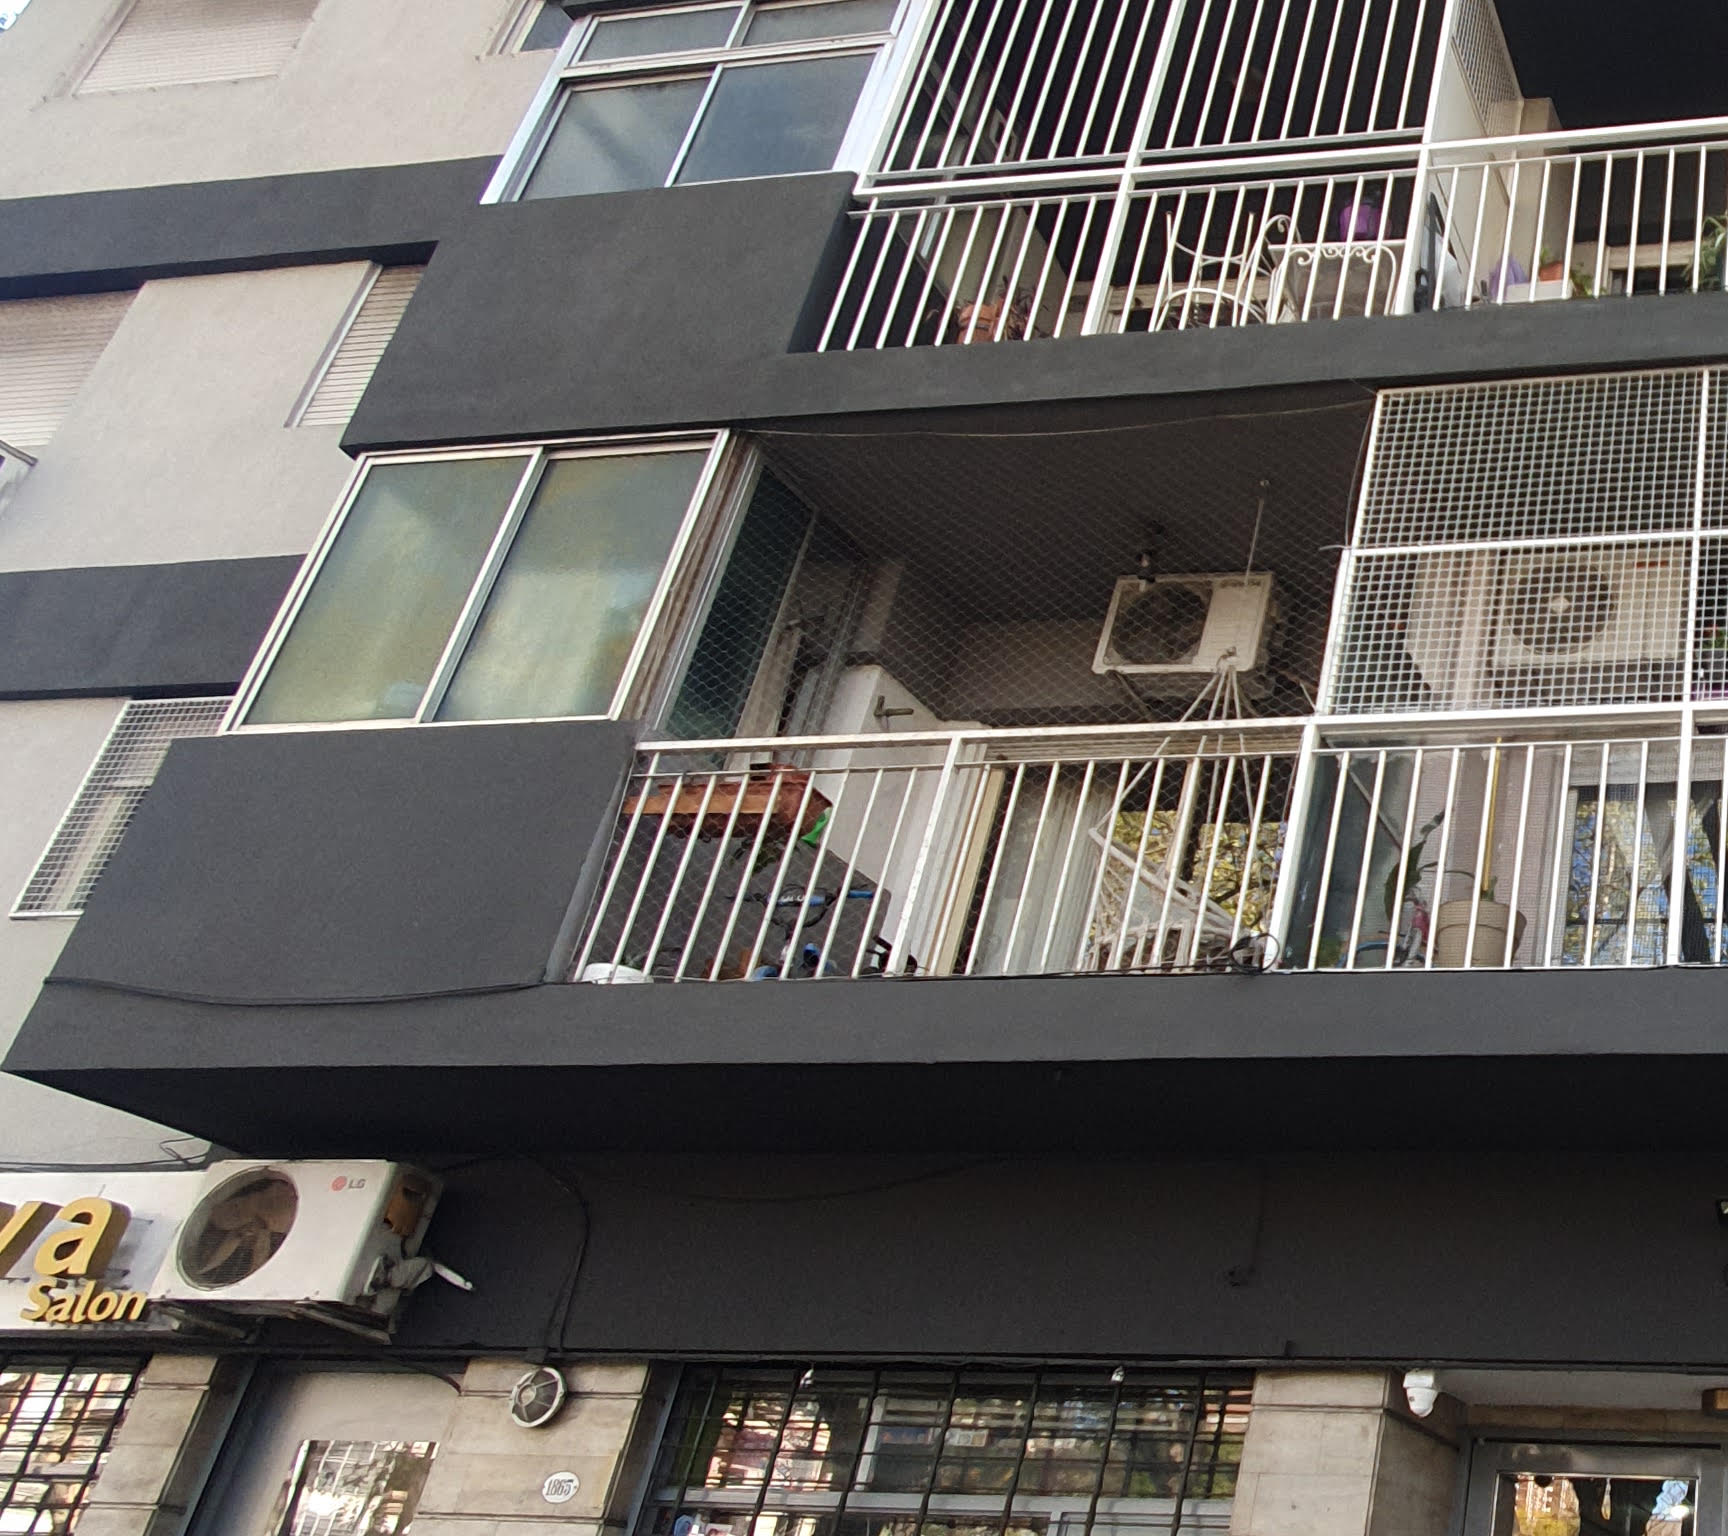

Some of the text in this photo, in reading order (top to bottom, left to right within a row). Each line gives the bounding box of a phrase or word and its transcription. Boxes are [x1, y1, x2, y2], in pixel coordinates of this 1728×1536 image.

[348, 1178, 367, 1189] LG
[19, 1277, 148, 1324] Salon
[545, 1478, 574, 1496] 1865
